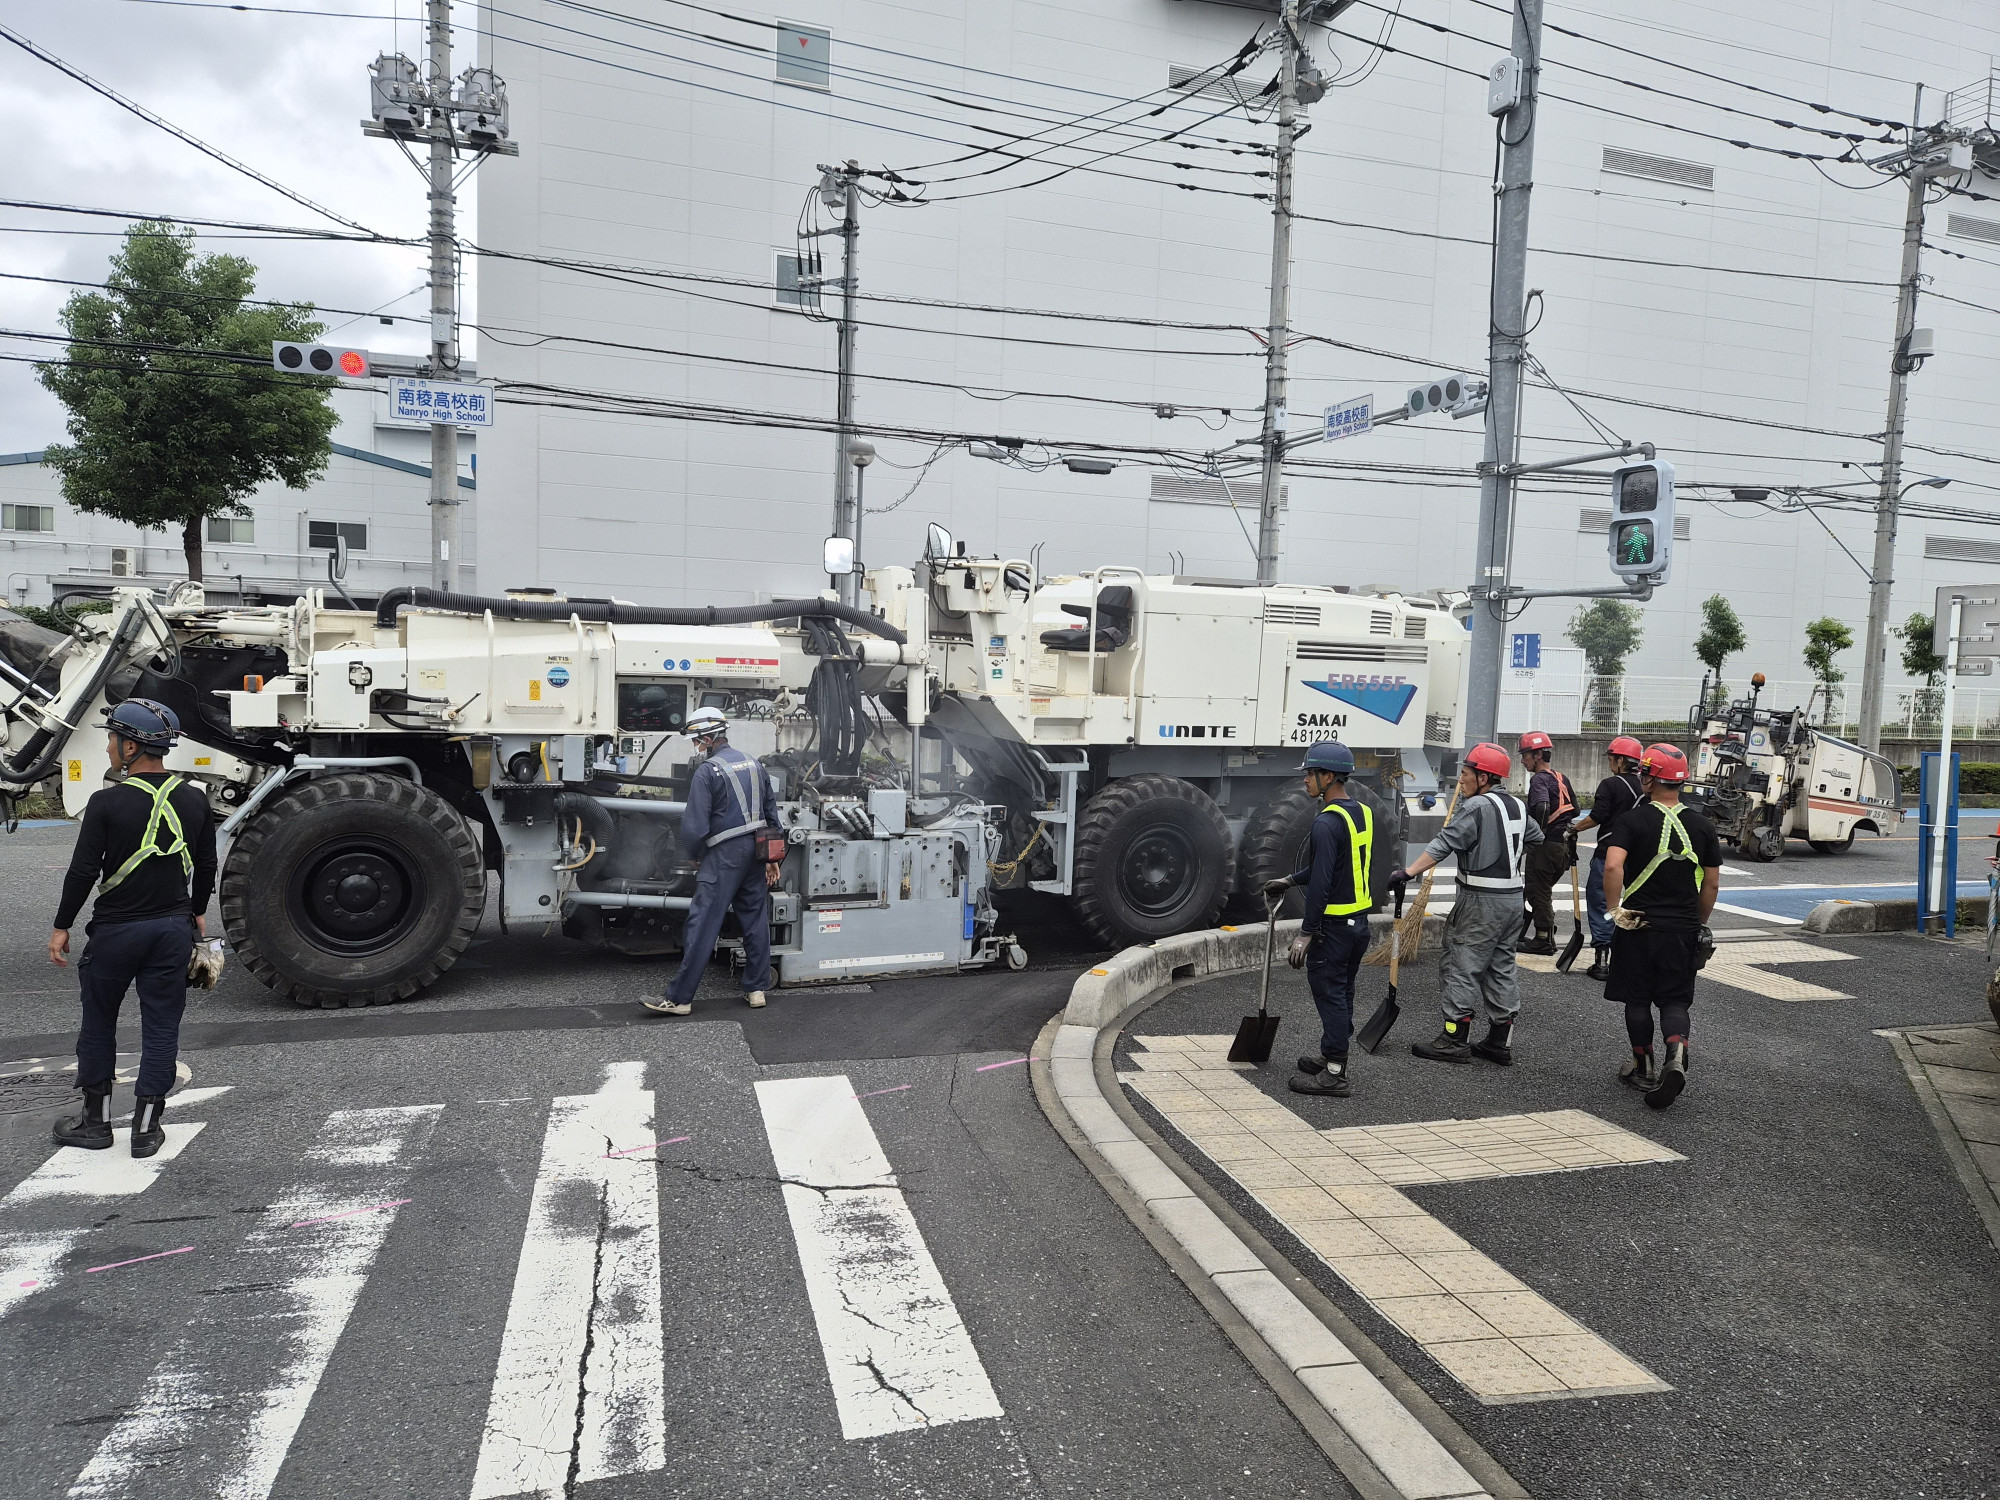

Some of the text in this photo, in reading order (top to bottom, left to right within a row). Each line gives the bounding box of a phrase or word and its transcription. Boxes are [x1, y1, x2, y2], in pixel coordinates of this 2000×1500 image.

[397, 378, 427, 387] 戸田市
[398, 388, 486, 412] 南稜高校前
[398, 405, 485, 422] Nanryo High School
[1327, 403, 1369, 429] 南稜高校前
[1327, 419, 1369, 438] Nanryo High School
[1327, 673, 1407, 691] ER555F
[1297, 713, 1347, 727] SAKAI
[1291, 729, 1338, 742] 481229
